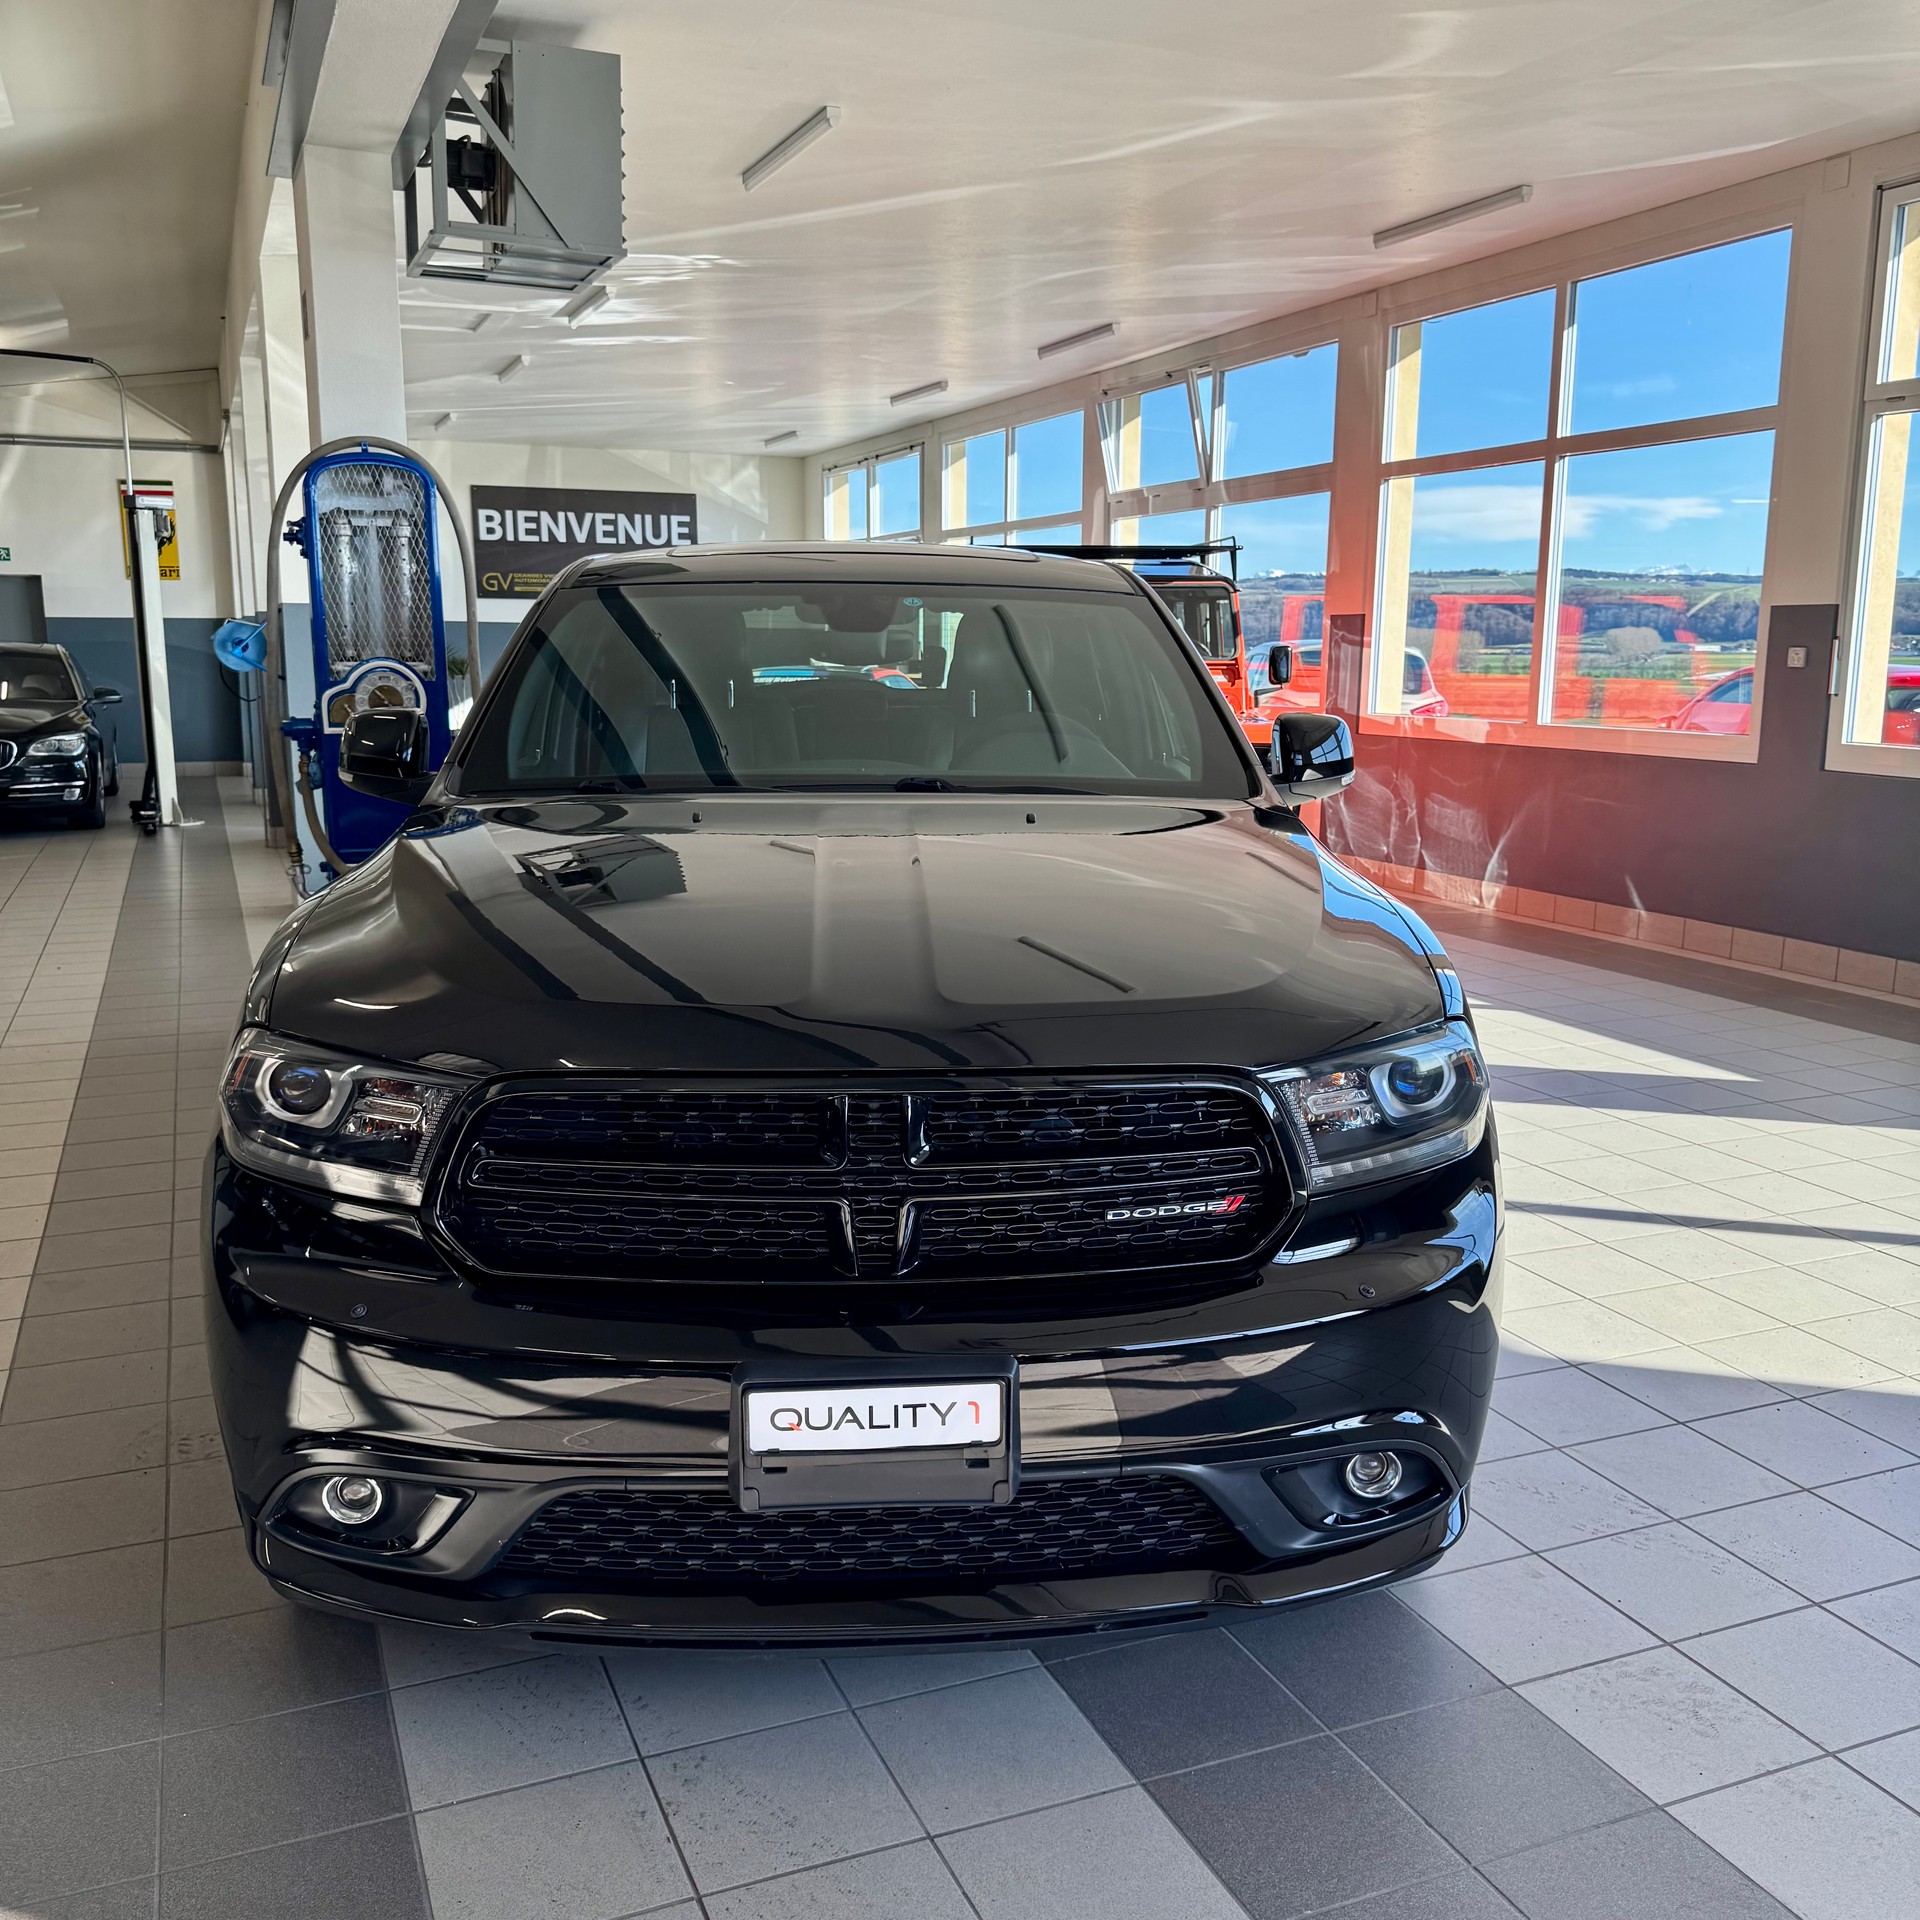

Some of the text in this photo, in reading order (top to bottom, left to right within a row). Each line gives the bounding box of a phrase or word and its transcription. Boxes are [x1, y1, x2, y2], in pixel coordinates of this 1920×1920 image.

[477, 508, 692, 546] BIENVENUE
[482, 572, 514, 592] GV
[1107, 1200, 1229, 1220] DODGE
[769, 1400, 981, 1432] QUALITY 1
